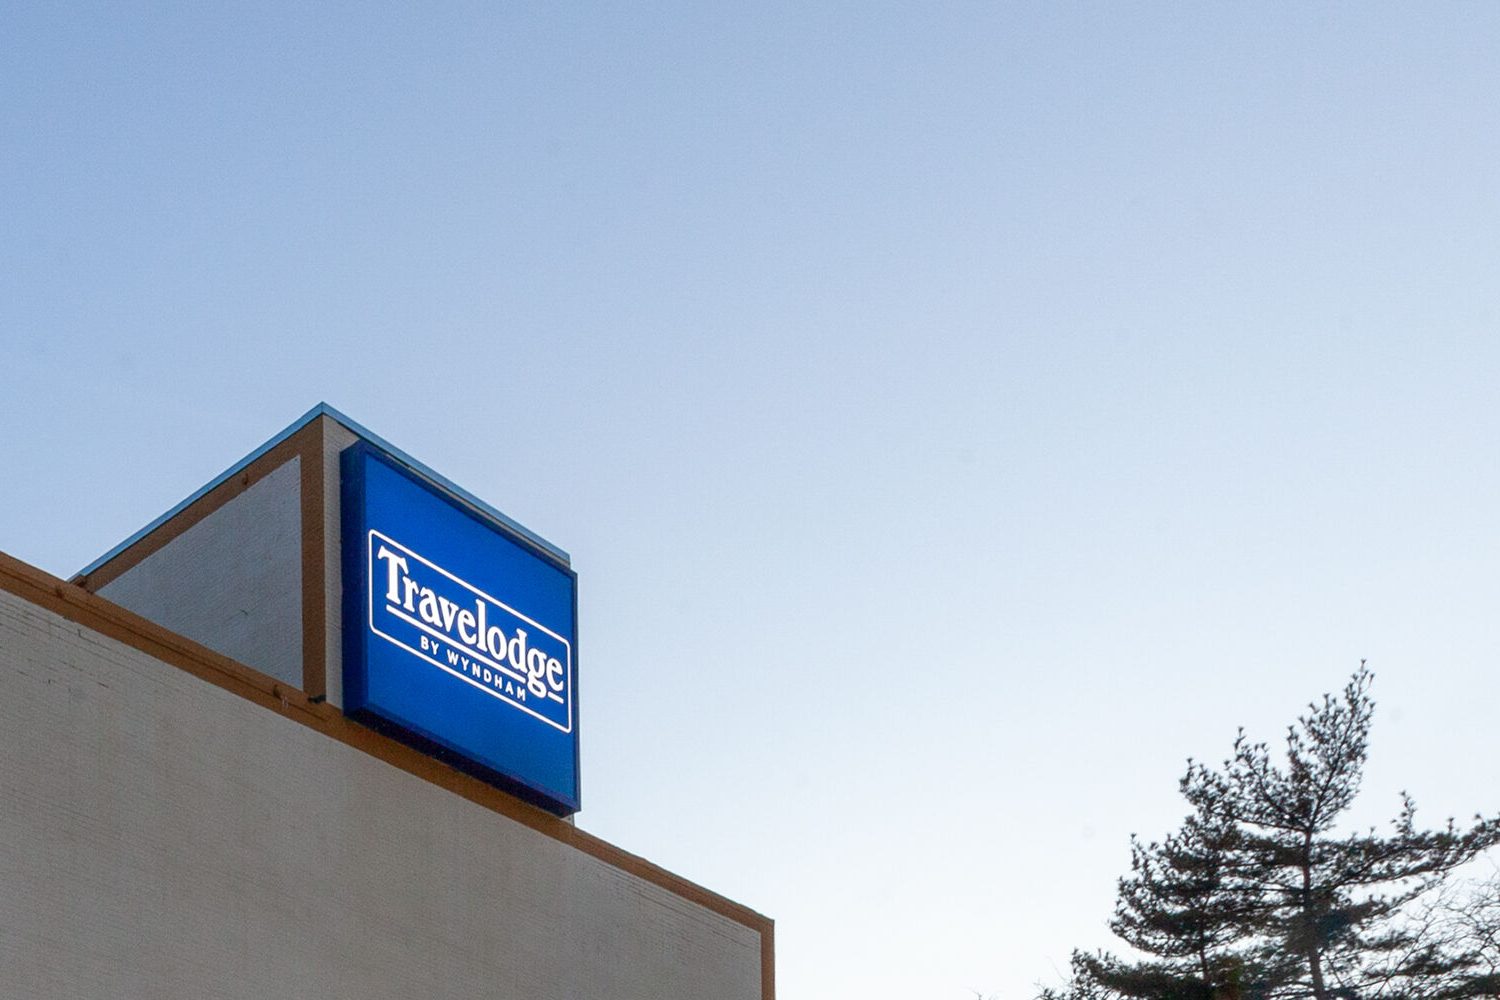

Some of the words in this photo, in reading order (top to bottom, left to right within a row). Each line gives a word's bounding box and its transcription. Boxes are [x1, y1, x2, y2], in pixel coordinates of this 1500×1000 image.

[378, 545, 564, 699] Travelodge
[420, 635, 440, 656] BY
[447, 653, 527, 702] WYNDHAM
